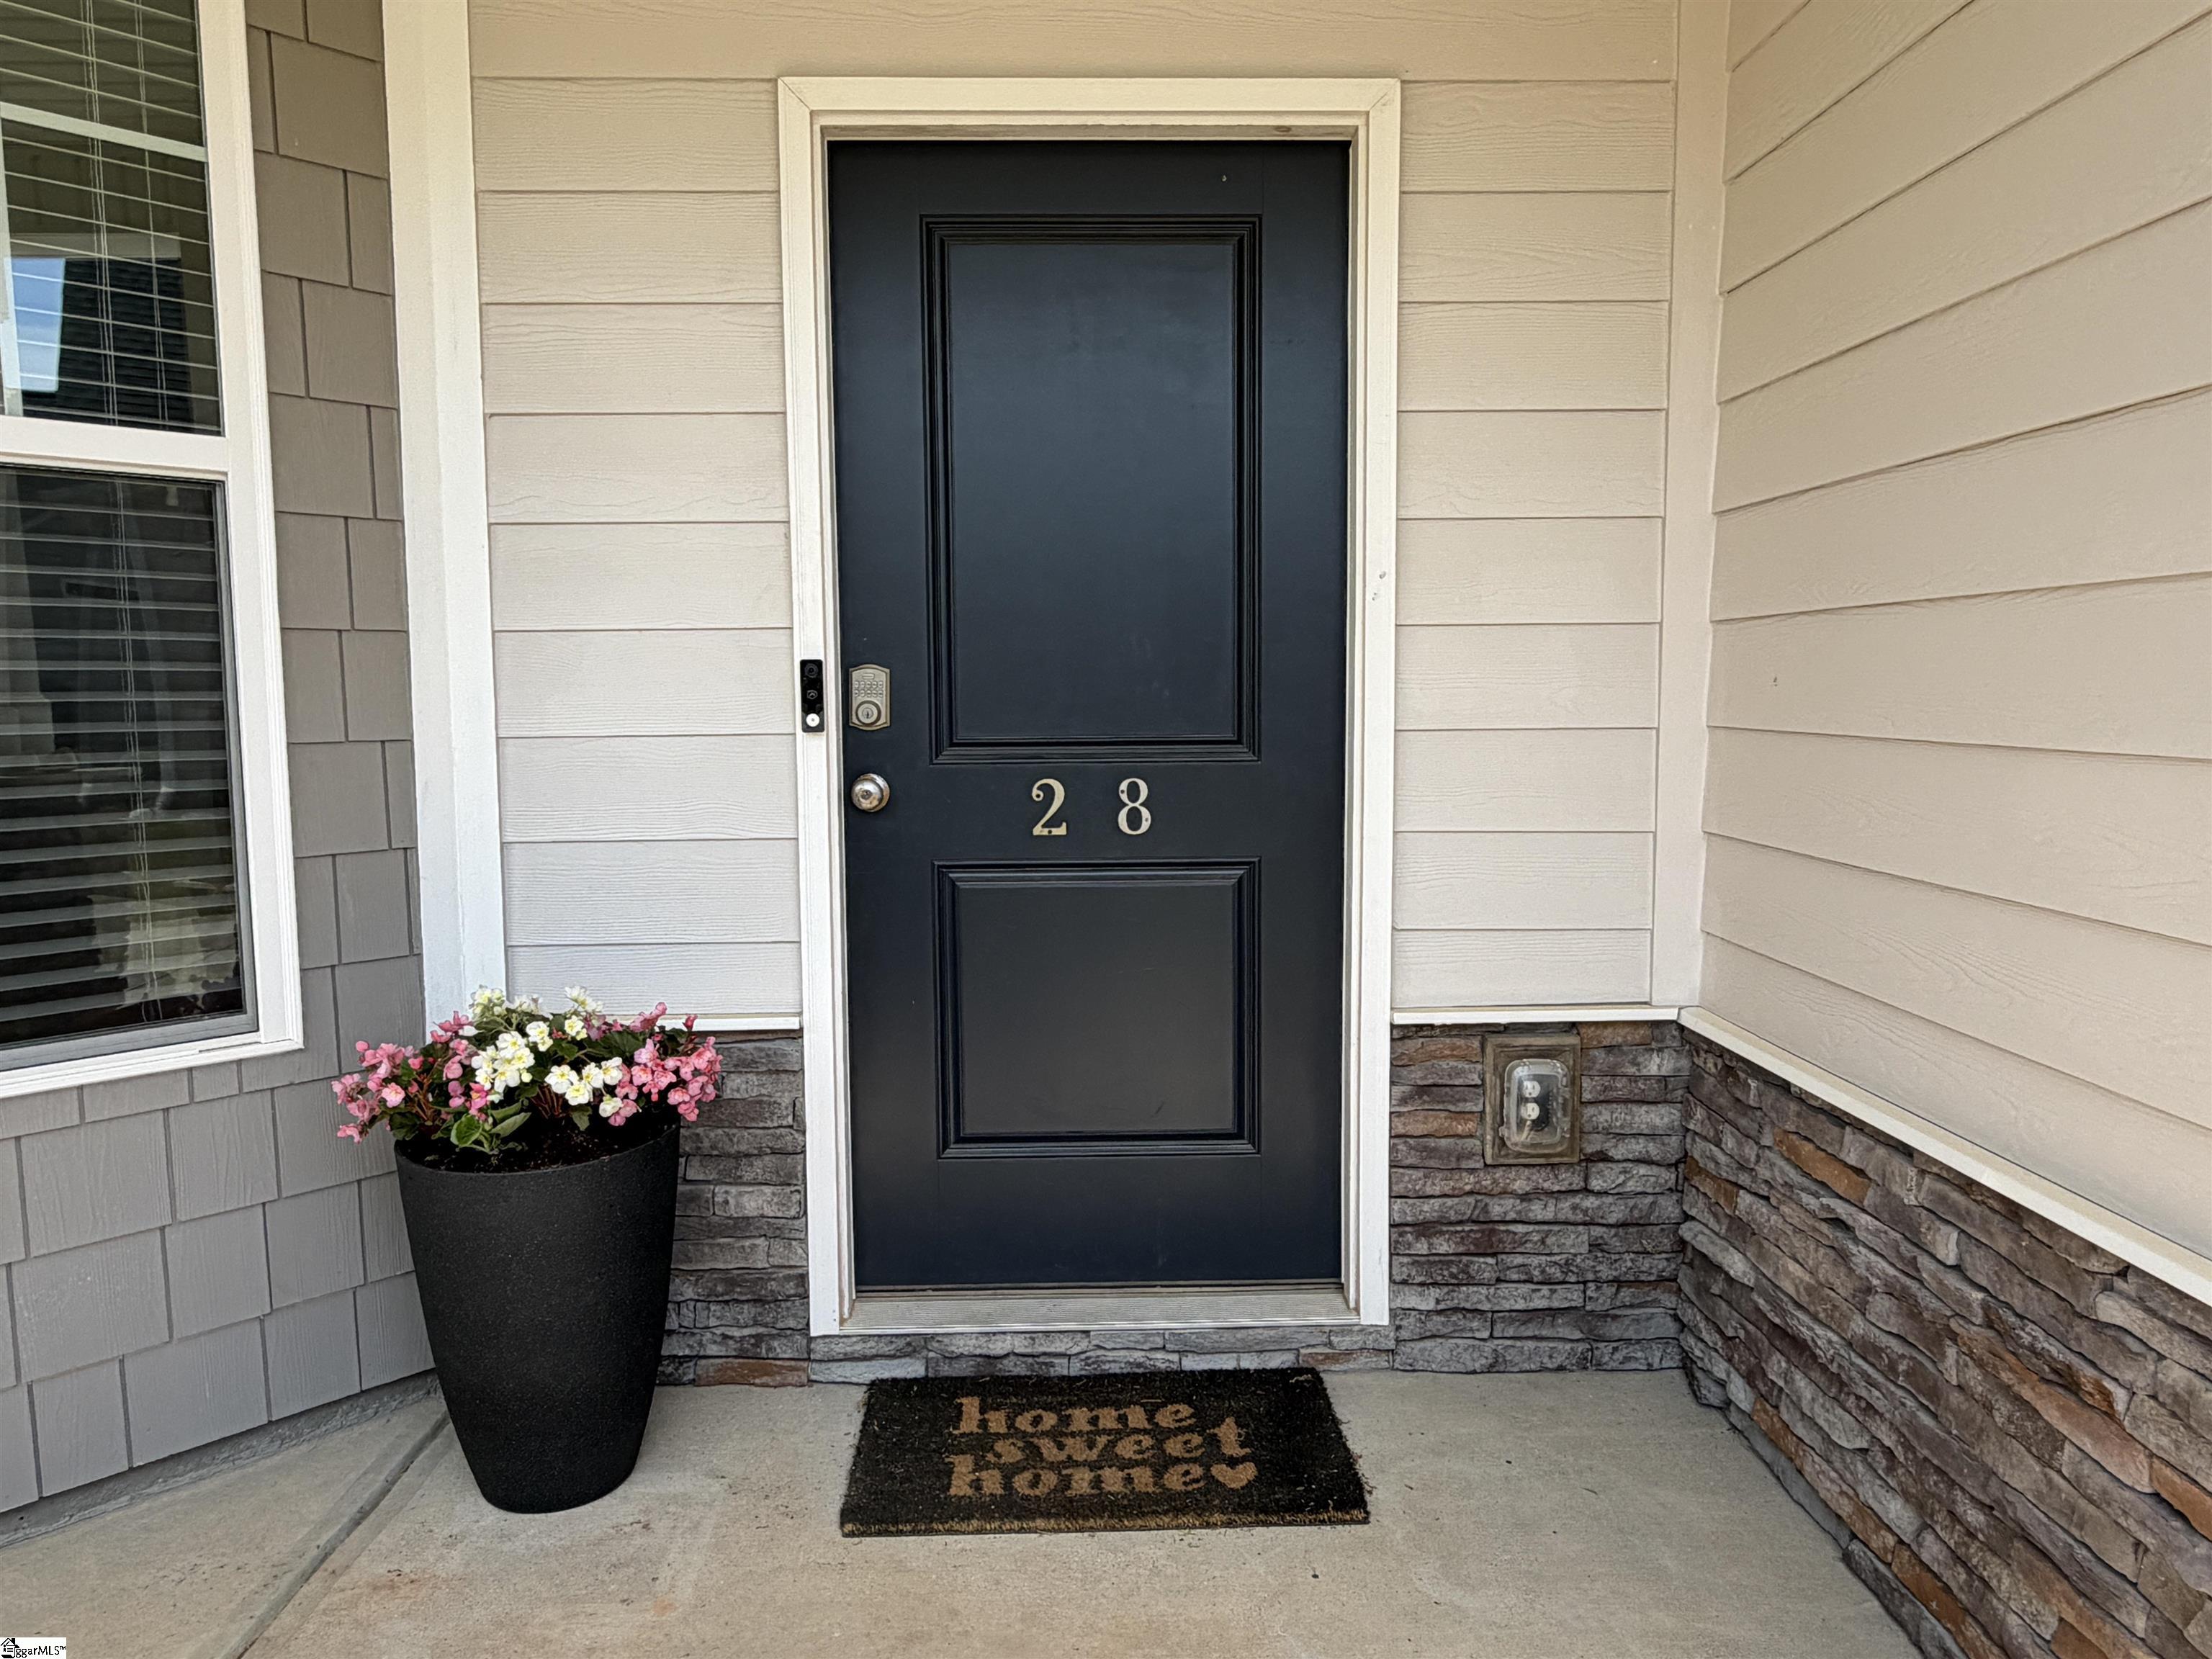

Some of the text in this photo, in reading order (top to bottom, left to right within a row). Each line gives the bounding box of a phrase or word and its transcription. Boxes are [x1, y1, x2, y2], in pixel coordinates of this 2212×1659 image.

[953, 1396, 1197, 1434] home
[985, 1416, 1252, 1463] sweet
[945, 1455, 1206, 1496] home
